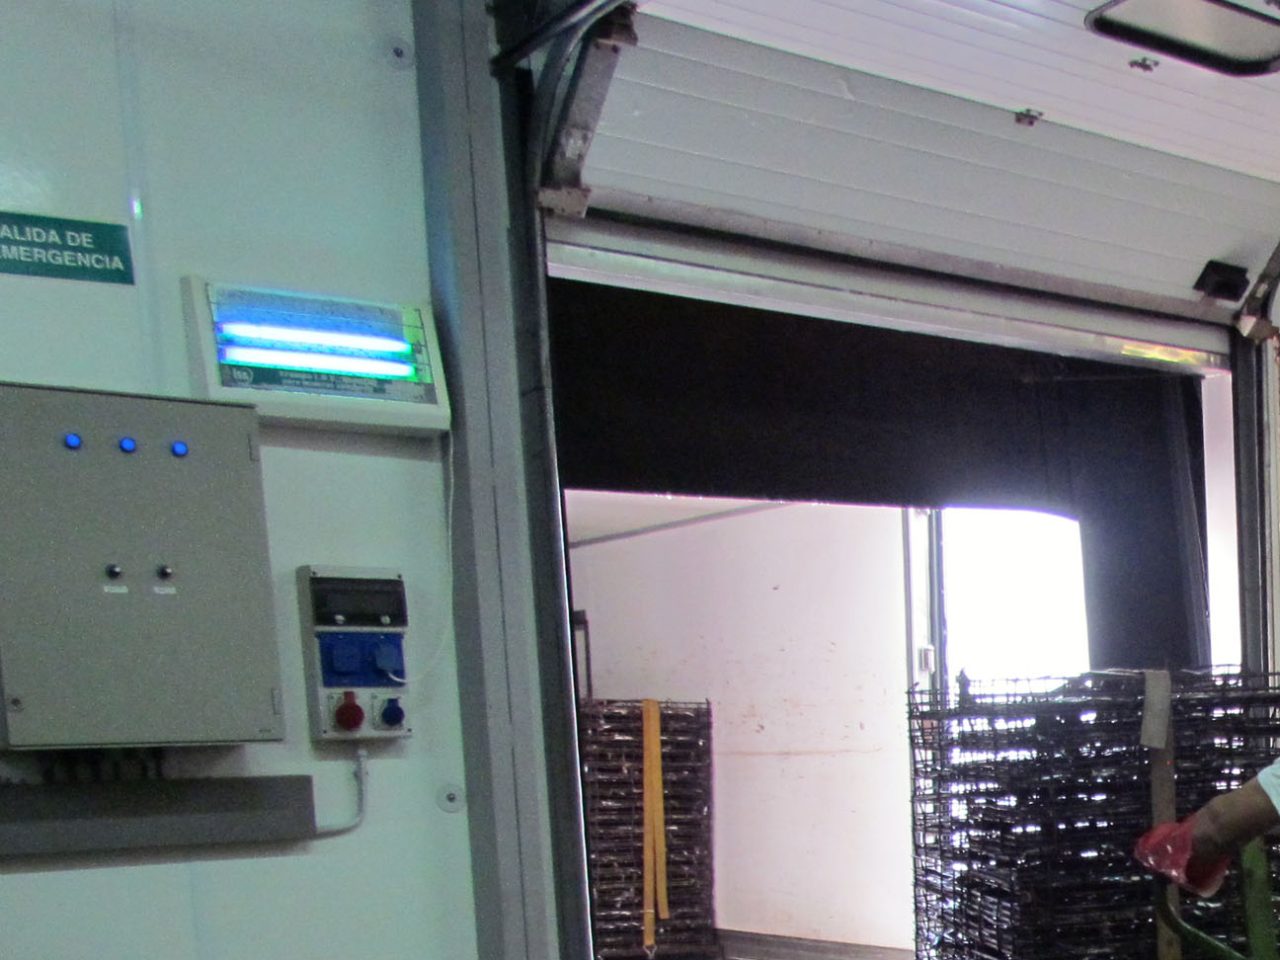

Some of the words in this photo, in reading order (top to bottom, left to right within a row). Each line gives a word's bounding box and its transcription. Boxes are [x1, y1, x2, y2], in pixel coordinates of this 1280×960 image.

[0, 223, 62, 245] ALIDA
[65, 230, 94, 248] DE
[0, 244, 124, 271] MERGENCIA
